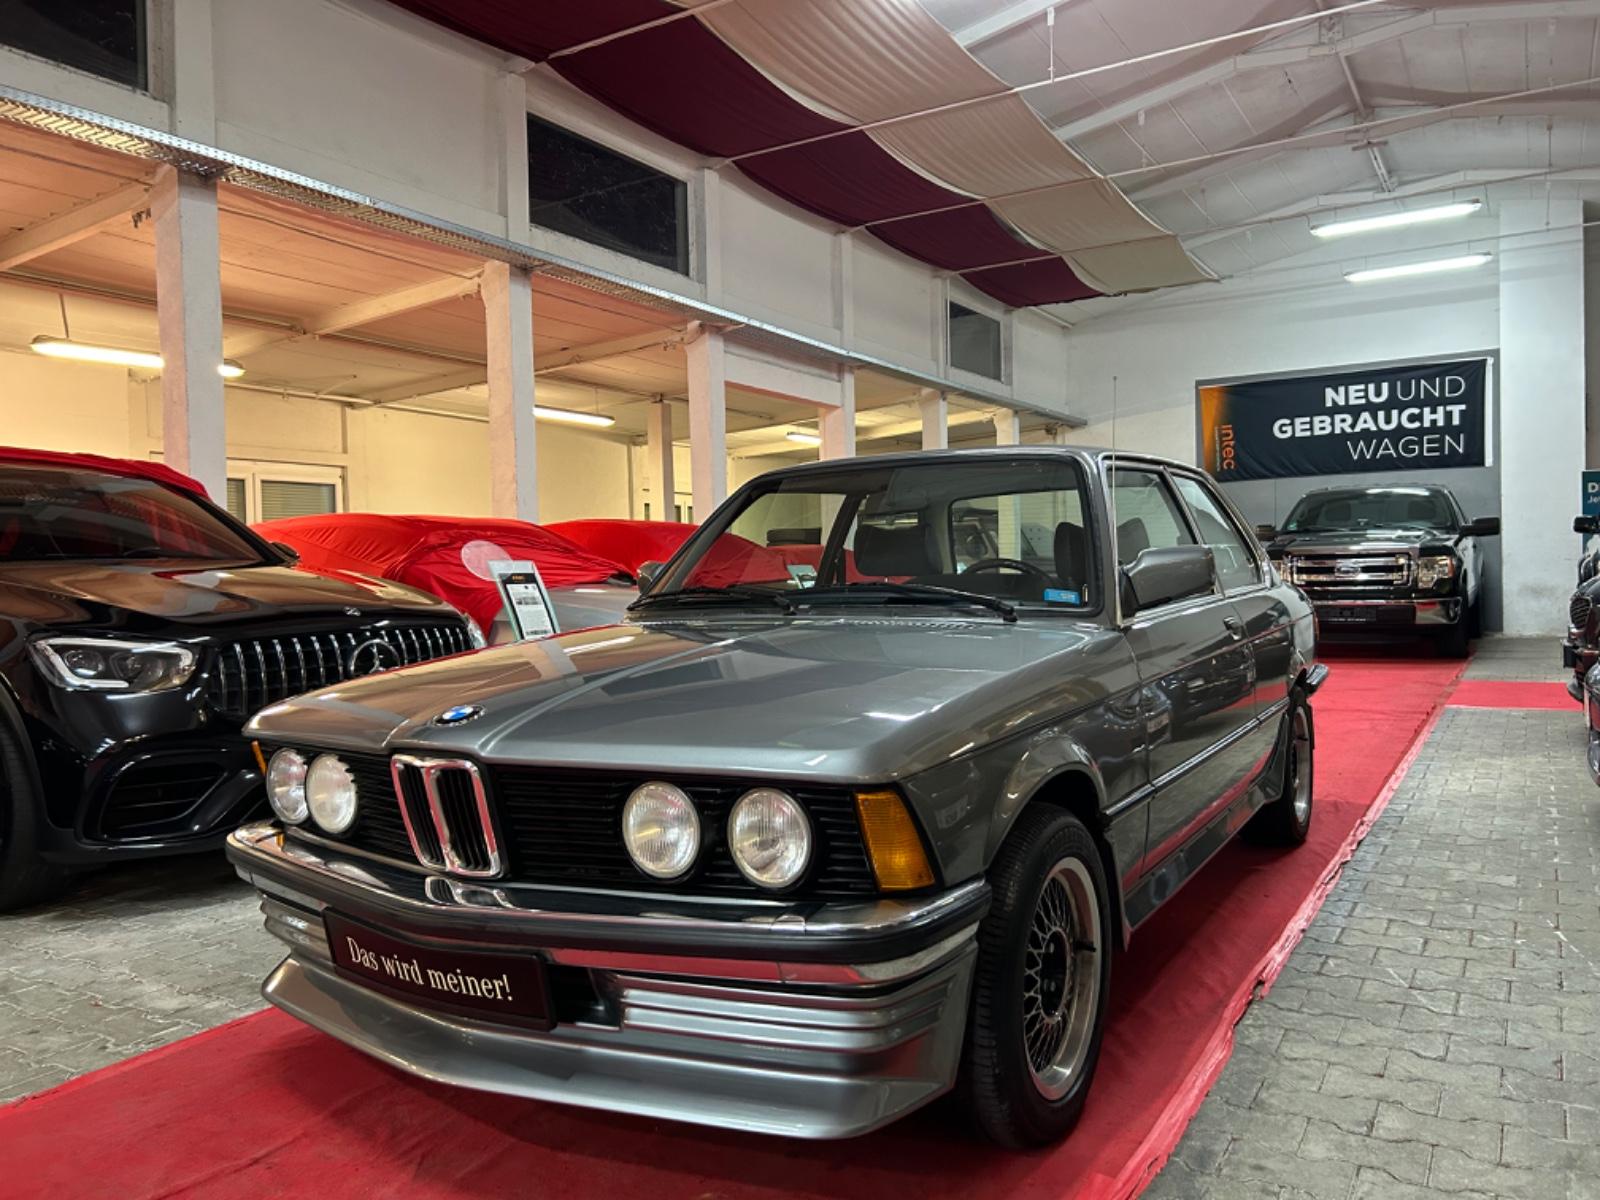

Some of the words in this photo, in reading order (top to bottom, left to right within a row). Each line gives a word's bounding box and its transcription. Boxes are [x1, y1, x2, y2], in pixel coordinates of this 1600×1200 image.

[1324, 381, 1389, 408] NEU
[1396, 375, 1467, 401] UND
[1272, 404, 1467, 439] GEBRAUCHT
[1347, 433, 1466, 460] WAGEN
[346, 936, 379, 971] Das
[381, 954, 425, 985] wird
[427, 968, 514, 1001] meiner!
